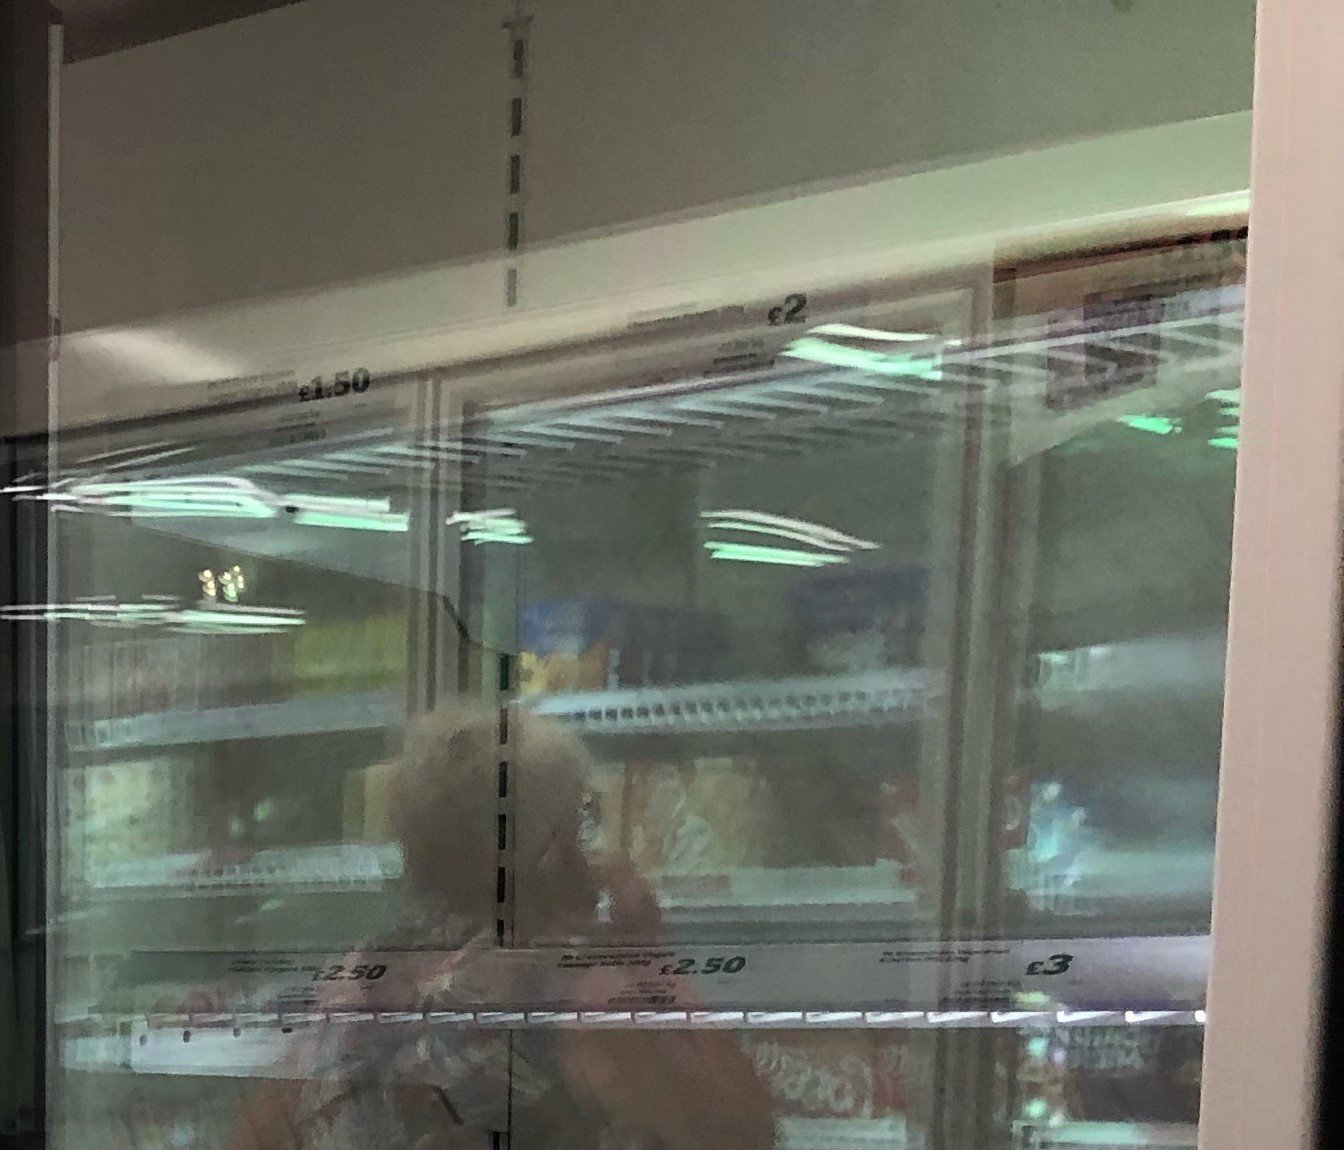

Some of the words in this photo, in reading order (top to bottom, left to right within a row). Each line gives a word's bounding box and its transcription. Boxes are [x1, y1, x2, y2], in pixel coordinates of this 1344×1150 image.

[767, 293, 807, 326] £2
[659, 956, 747, 976] £2.50
[1025, 954, 1074, 975] £3
